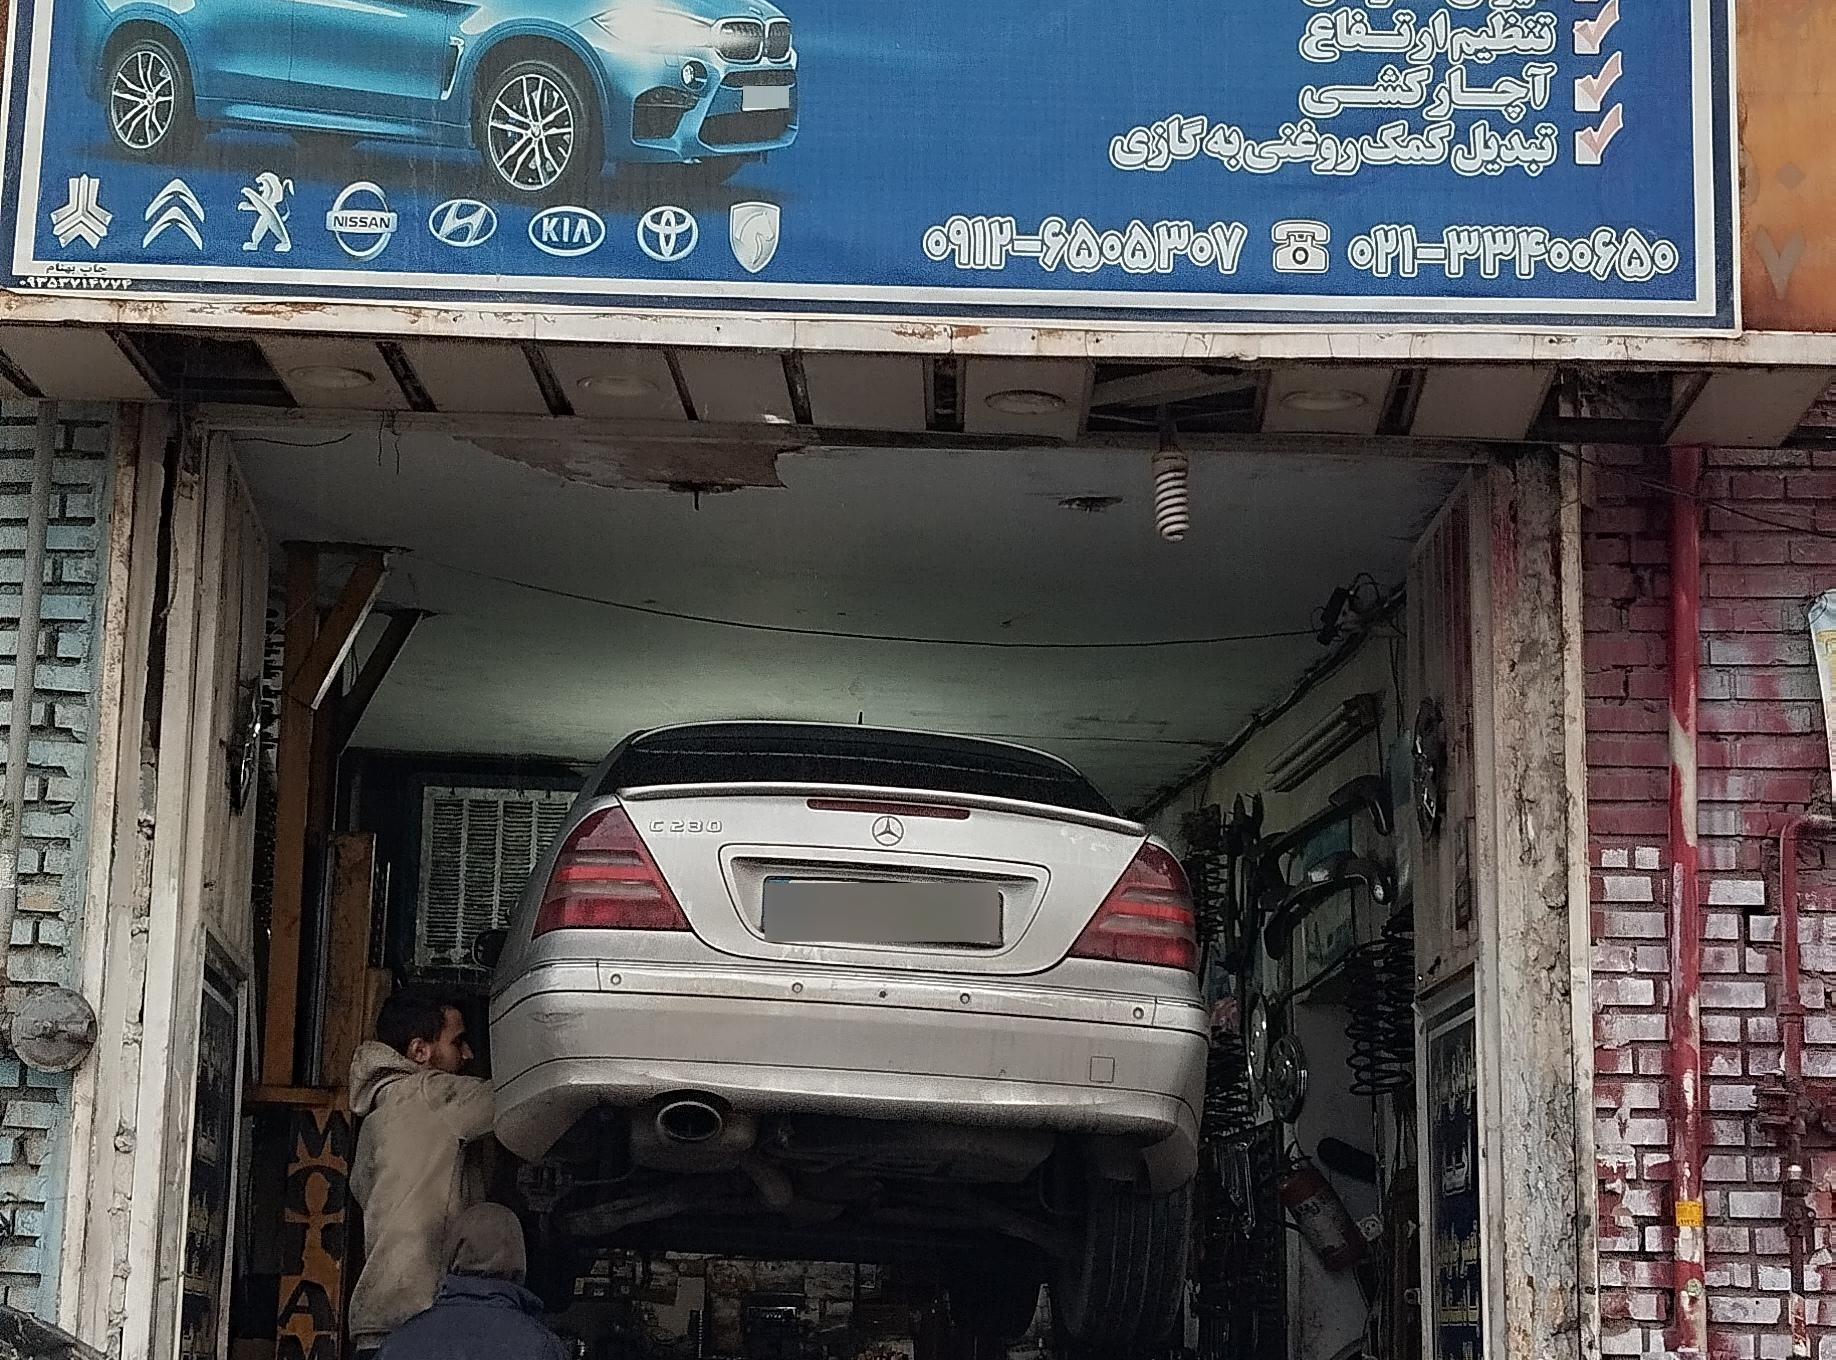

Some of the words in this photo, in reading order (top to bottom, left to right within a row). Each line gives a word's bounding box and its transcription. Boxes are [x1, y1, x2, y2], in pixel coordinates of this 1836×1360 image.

[1299, 8, 1449, 63] ارتفاع
[1449, 10, 1557, 65] تنظیم
[1299, 64, 1432, 117] کشی
[1423, 62, 1557, 122] آچار
[1109, 114, 1207, 170] گازی
[1203, 121, 1243, 171] به
[1242, 118, 1360, 176] روغنی
[1360, 120, 1453, 164] کمک
[1451, 120, 1558, 176] تبدیل
[333, 215, 390, 230] NISSAN
[541, 218, 592, 244] KIA
[923, 215, 1247, 274] ۰۹۱۲-۶۵۰۵۳۰۷
[1348, 225, 1678, 282] ۰۲۱-۳۳۴۰۰۶۵۰
[650, 820, 664, 833] C
